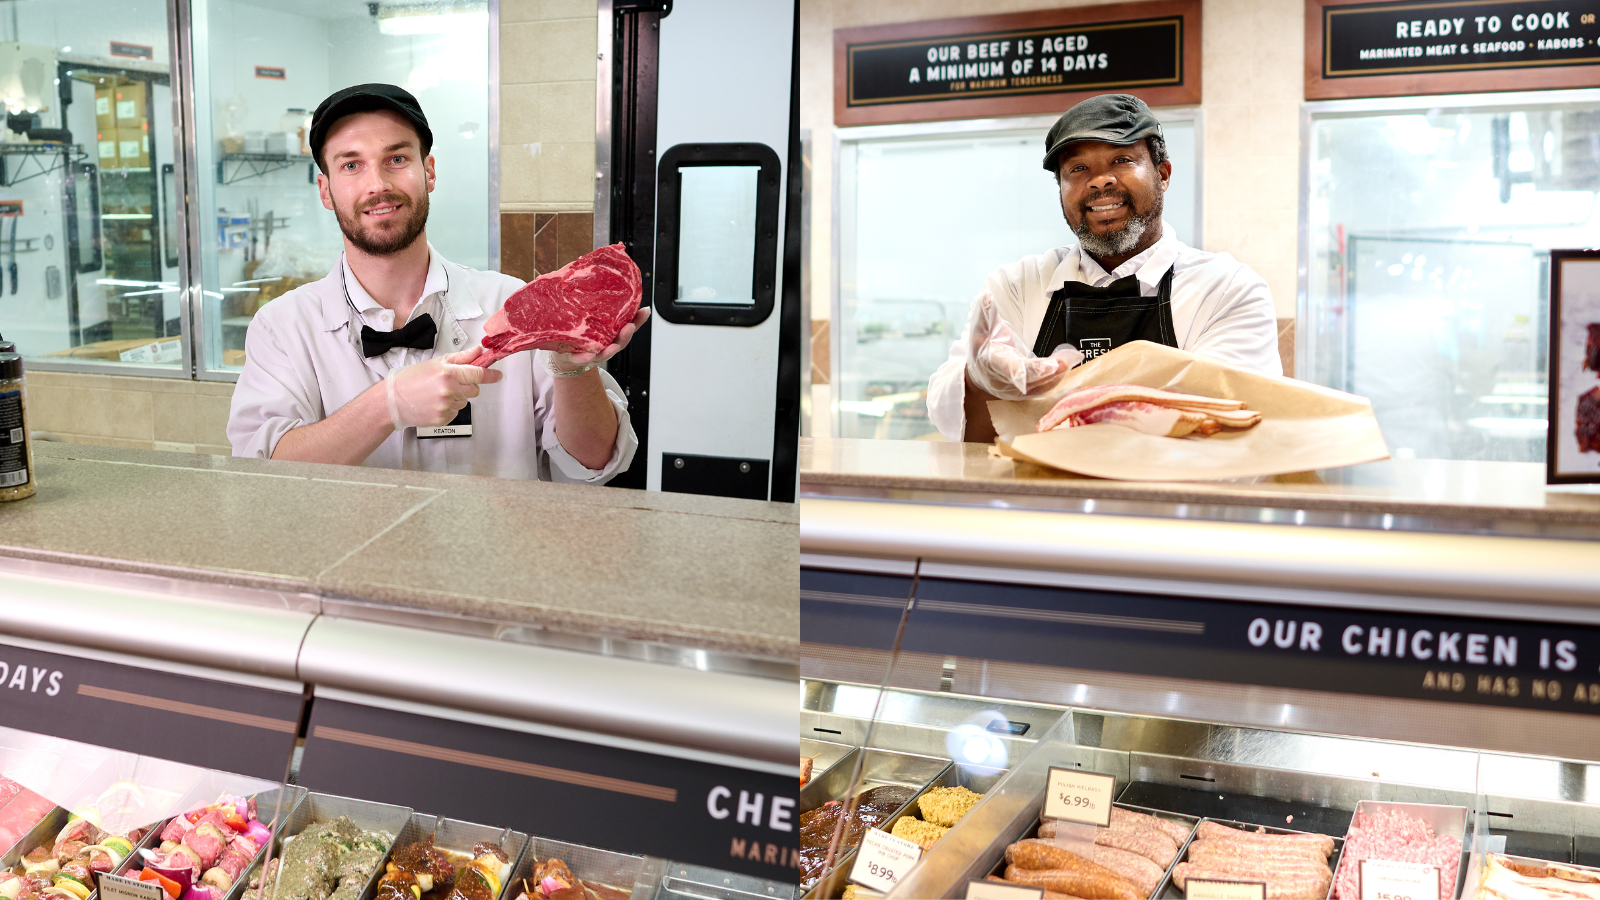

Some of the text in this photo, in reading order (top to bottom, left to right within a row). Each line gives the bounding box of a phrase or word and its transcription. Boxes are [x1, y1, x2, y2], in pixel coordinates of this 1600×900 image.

[1396, 11, 1596, 38] READY TO COOK OR
[927, 35, 1088, 63] OUR BEEF IS AGED
[1359, 46, 1423, 60] MARINATED
[1426, 44, 1458, 57] MEAT
[1460, 43, 1470, 54] &
[1473, 40, 1526, 54] SEAFOOD
[1537, 37, 1585, 50] KABOBS
[909, 53, 1108, 83] A MINIMUM OF 14 DAYS
[950, 74, 1063, 91] FOR MAXIMUM TENDERNESS
[1248, 618, 1578, 671] OUR CHICKEN IS
[0, 661, 64, 697] DAYS
[1422, 670, 1466, 693] AND
[1477, 674, 1520, 698] HAS
[1532, 679, 1562, 701] NO
[707, 785, 796, 833] CHE
[866, 839, 880, 848] PECAN
[882, 845, 901, 855] CRUSTED
[106, 875, 123, 883] MADE
[132, 882, 153, 891] STORE
[119, 889, 138, 898] MIGNON
